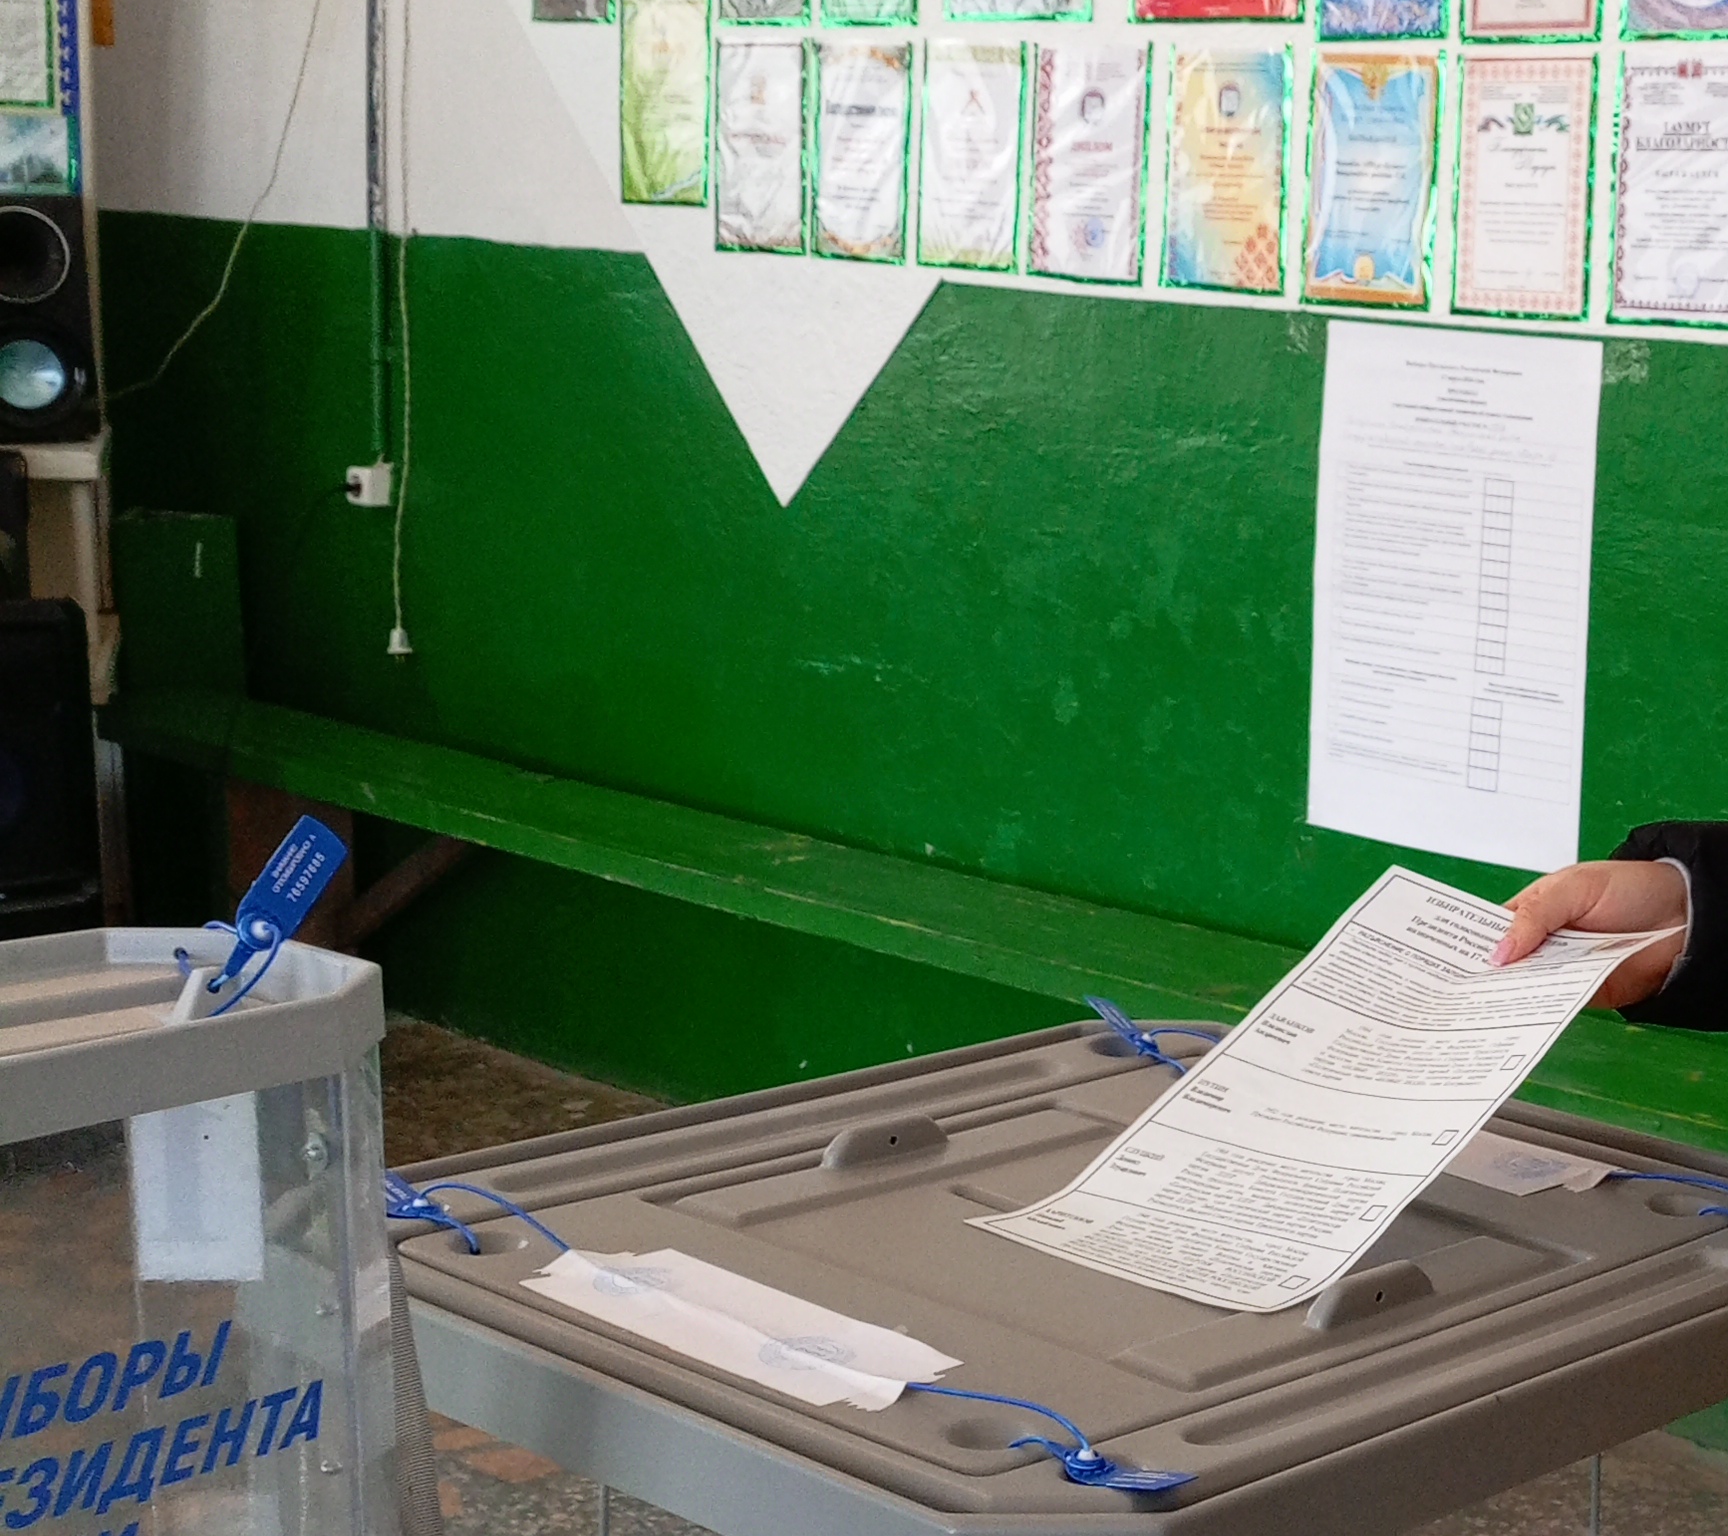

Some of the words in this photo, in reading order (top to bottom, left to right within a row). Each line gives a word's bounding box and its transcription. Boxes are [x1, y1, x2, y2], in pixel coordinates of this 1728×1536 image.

[1426, 895, 1510, 934] ИЗБИРАТЕЛЬНЫ
[1411, 915, 1459, 940] Президента
[1450, 921, 1501, 944] голосовани
[1471, 952, 1481, 961] 17
